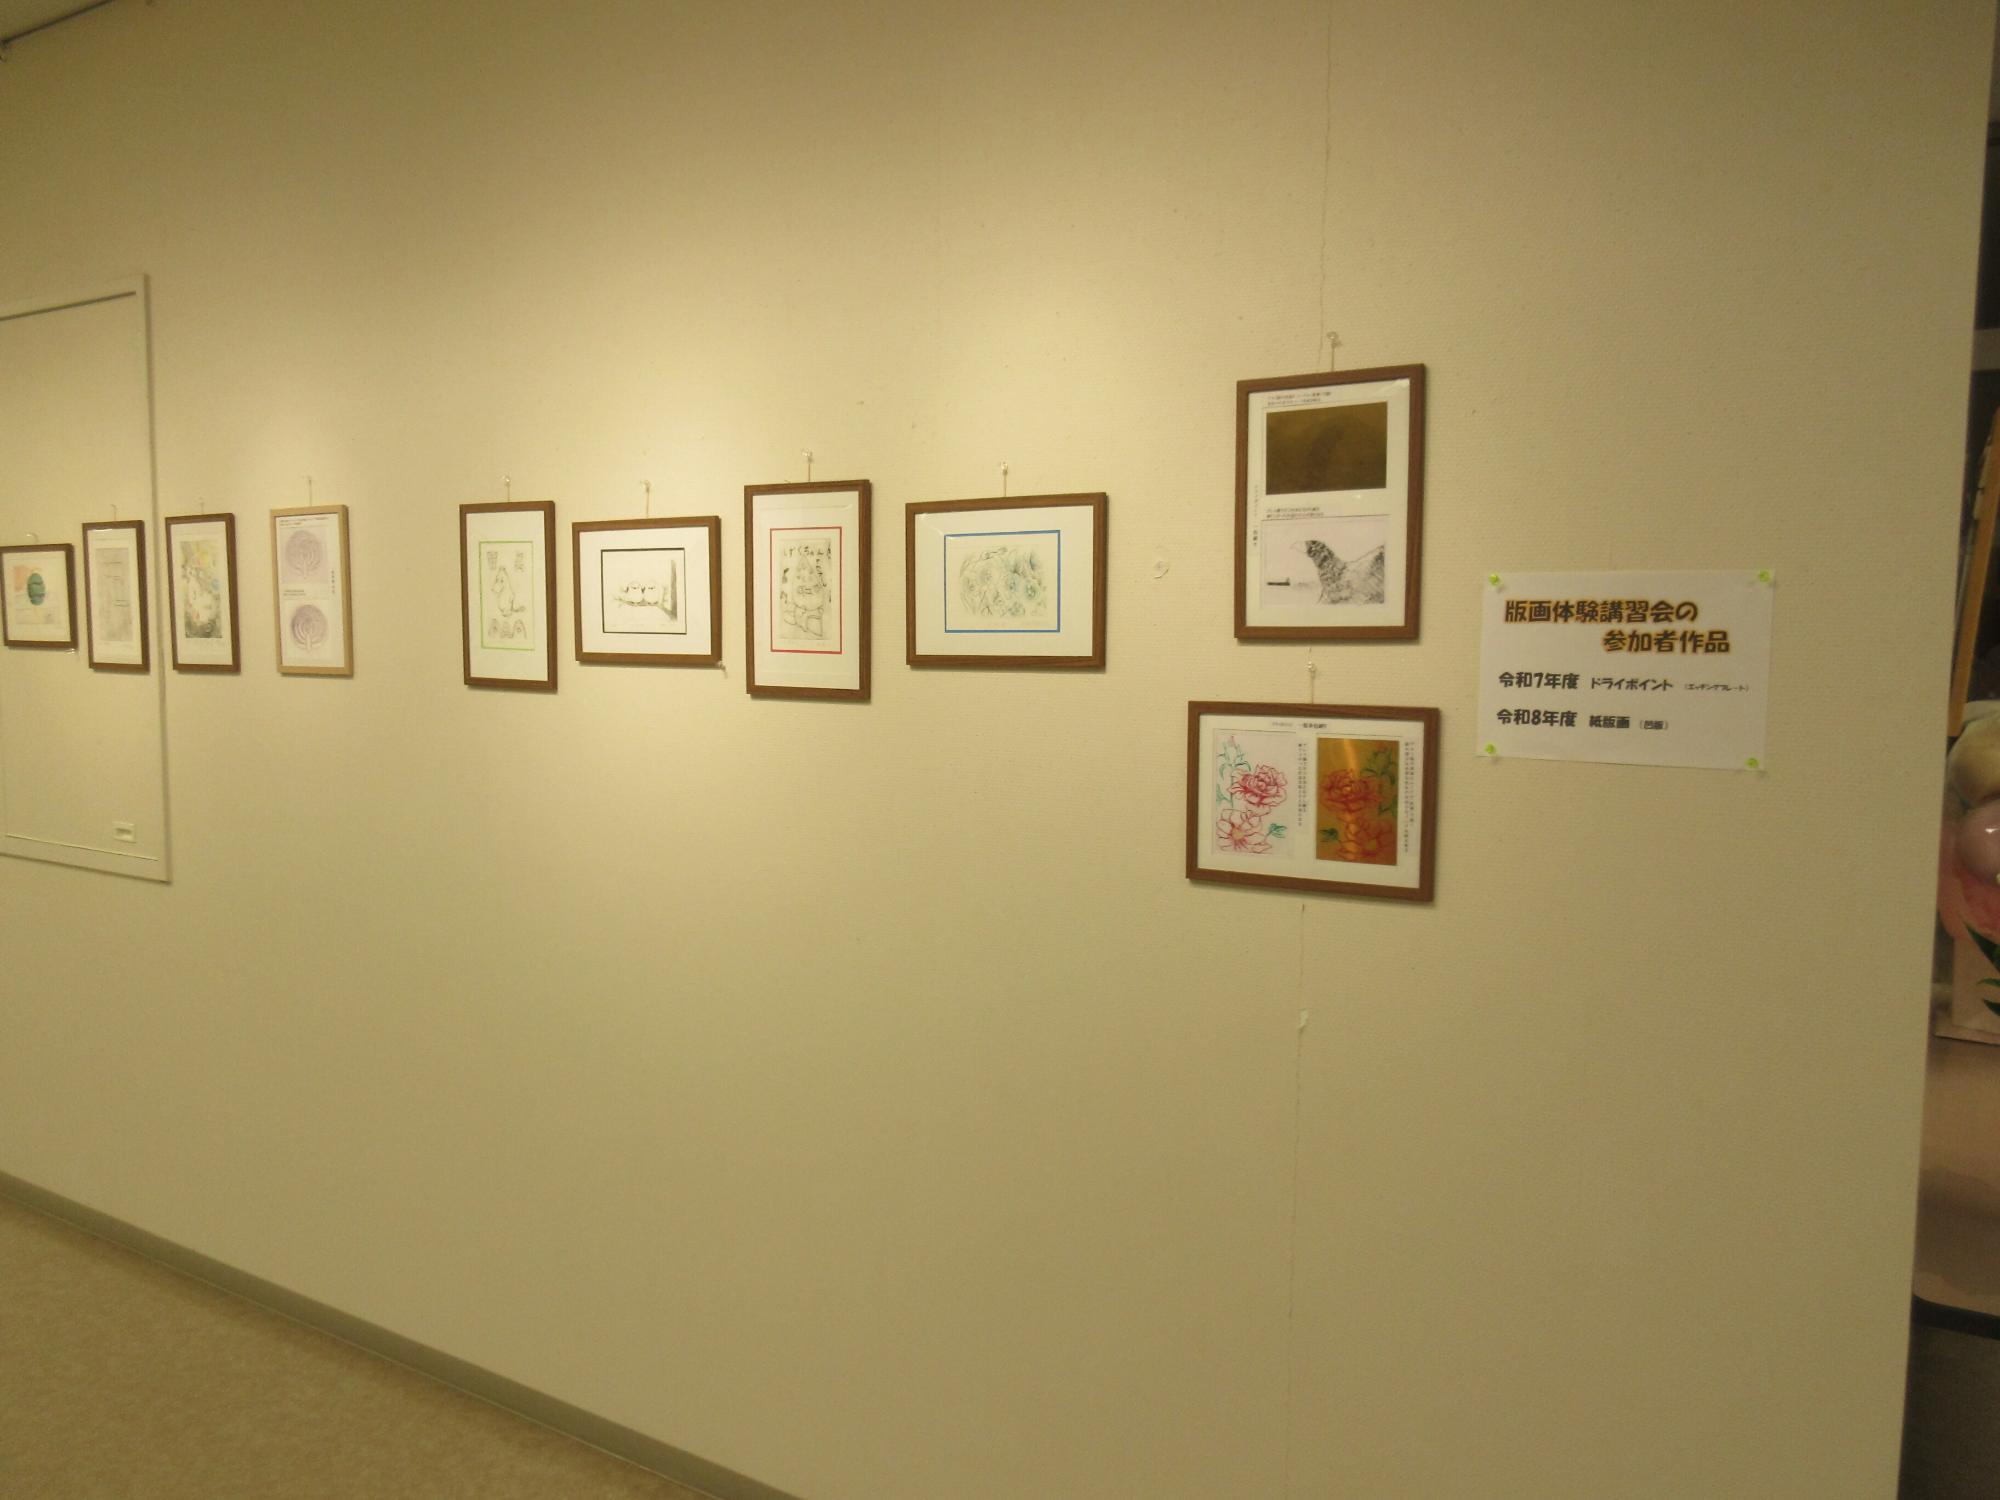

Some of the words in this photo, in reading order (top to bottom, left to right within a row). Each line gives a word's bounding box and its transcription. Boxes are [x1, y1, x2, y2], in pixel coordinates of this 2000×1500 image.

[1504, 600, 1698, 624] 版画体験講習会の
[1602, 630, 1731, 653] 参加者作品
[1498, 671, 1580, 690] 令和7年度
[1591, 677, 1674, 692] ドライポイント
[1496, 708, 1578, 728] 令和8年度
[1588, 715, 1630, 729] 紙版画
